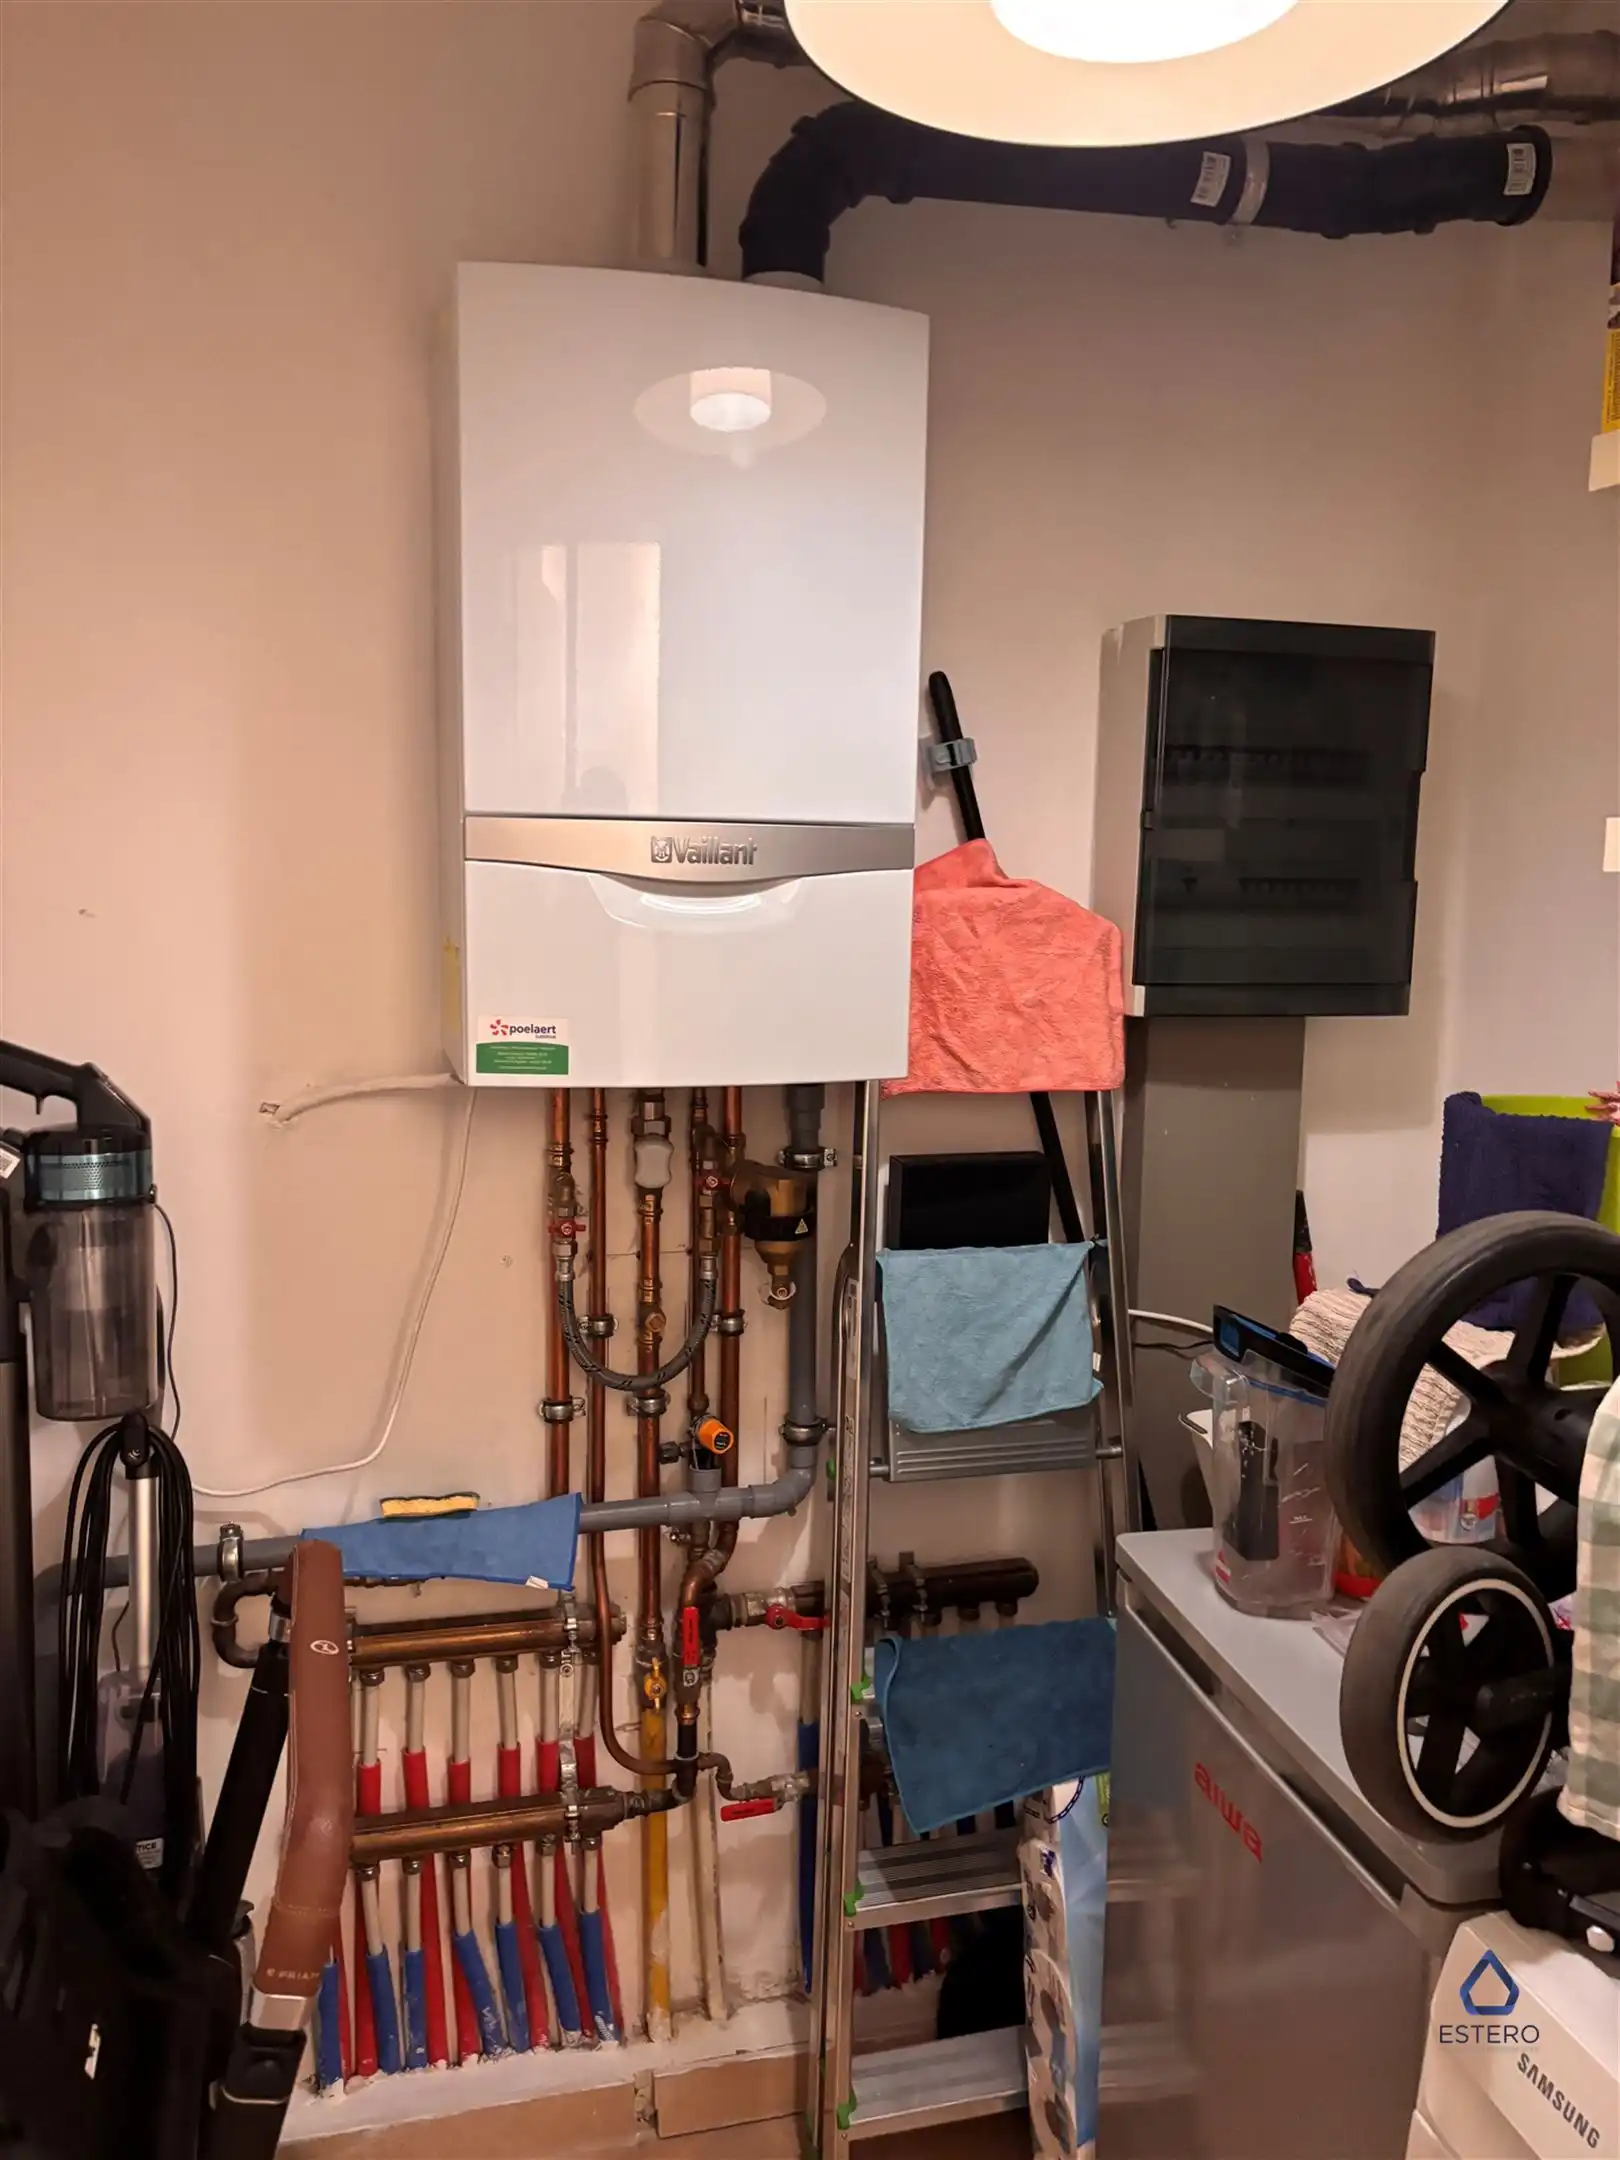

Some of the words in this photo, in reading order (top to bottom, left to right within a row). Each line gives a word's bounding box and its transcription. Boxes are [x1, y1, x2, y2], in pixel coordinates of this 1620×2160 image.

[673, 836, 757, 865] Vaillant
[509, 1023, 556, 1035] poelaert
[1194, 1761, 1263, 1864] aiwa
[1517, 2052, 1600, 2149] SAMSUNG
